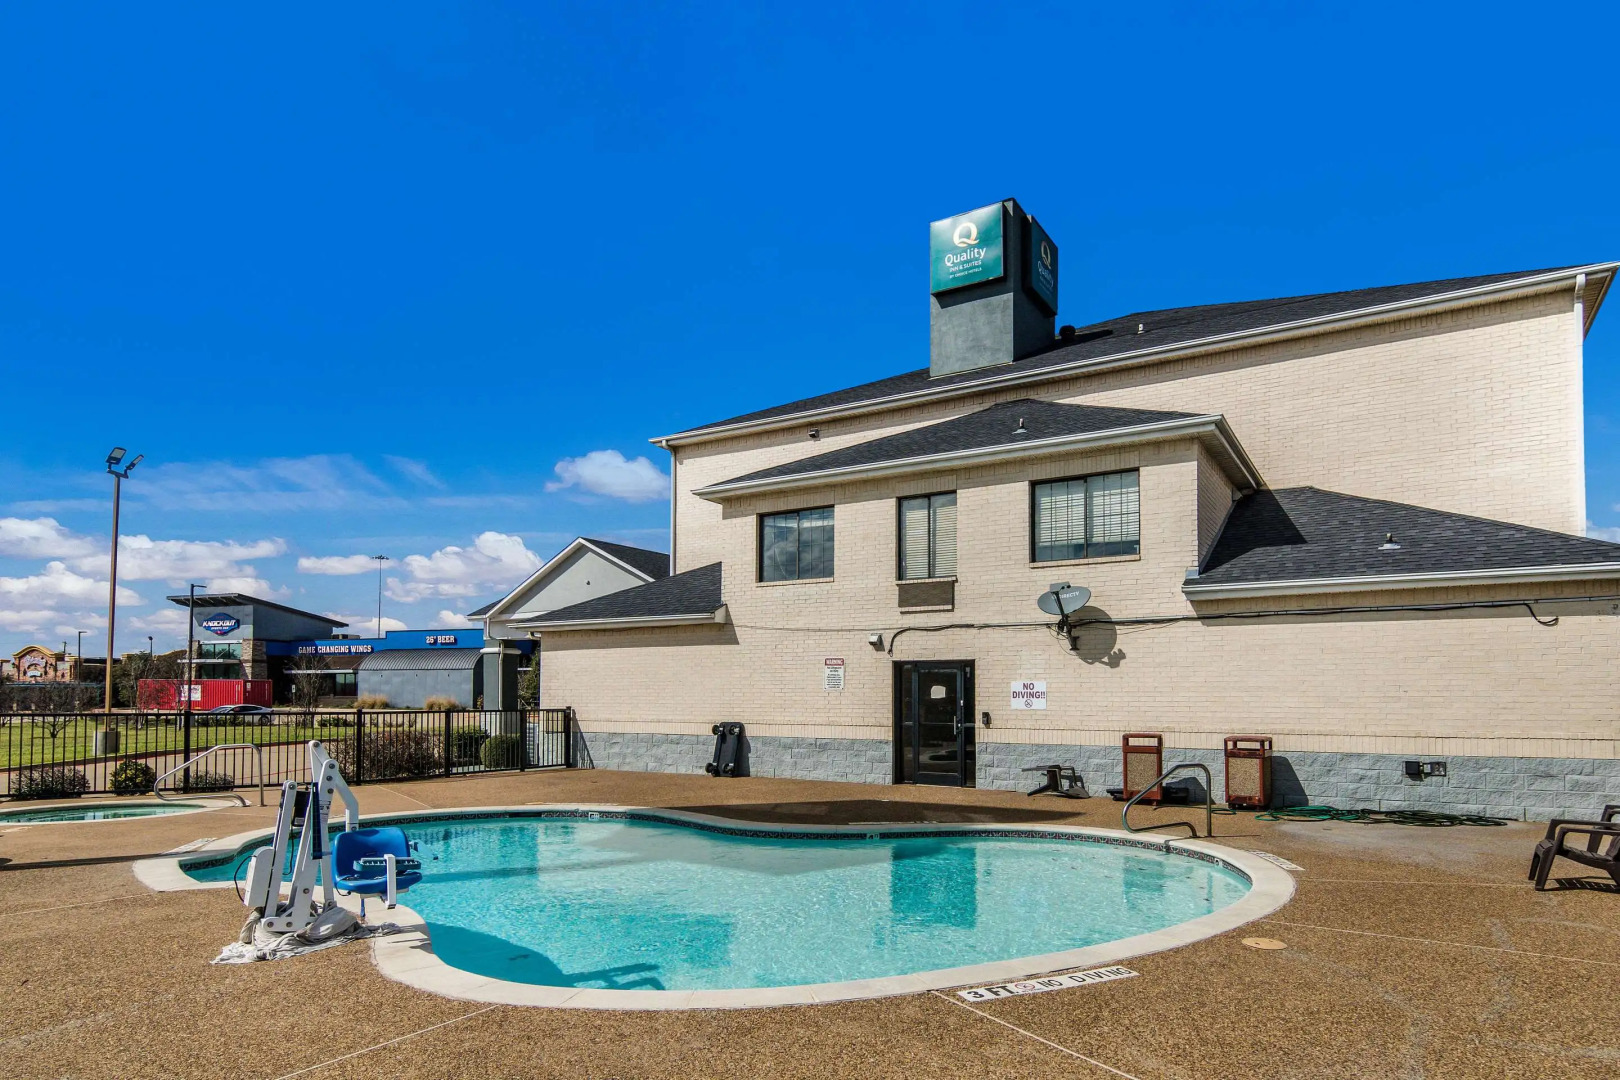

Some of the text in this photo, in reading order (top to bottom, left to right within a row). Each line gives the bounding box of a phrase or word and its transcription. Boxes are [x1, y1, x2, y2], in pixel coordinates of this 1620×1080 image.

[953, 222, 979, 247] Q
[944, 247, 986, 267] Quality
[963, 260, 982, 269] SUITES
[437, 635, 455, 643] BEER
[298, 644, 372, 654] GAME CHANGING WINGS
[1022, 682, 1035, 691] NO
[1012, 690, 1046, 699] DIVING!!
[966, 990, 985, 999] 3
[1036, 979, 1064, 989] NO
[1068, 967, 1132, 983] DIVING
